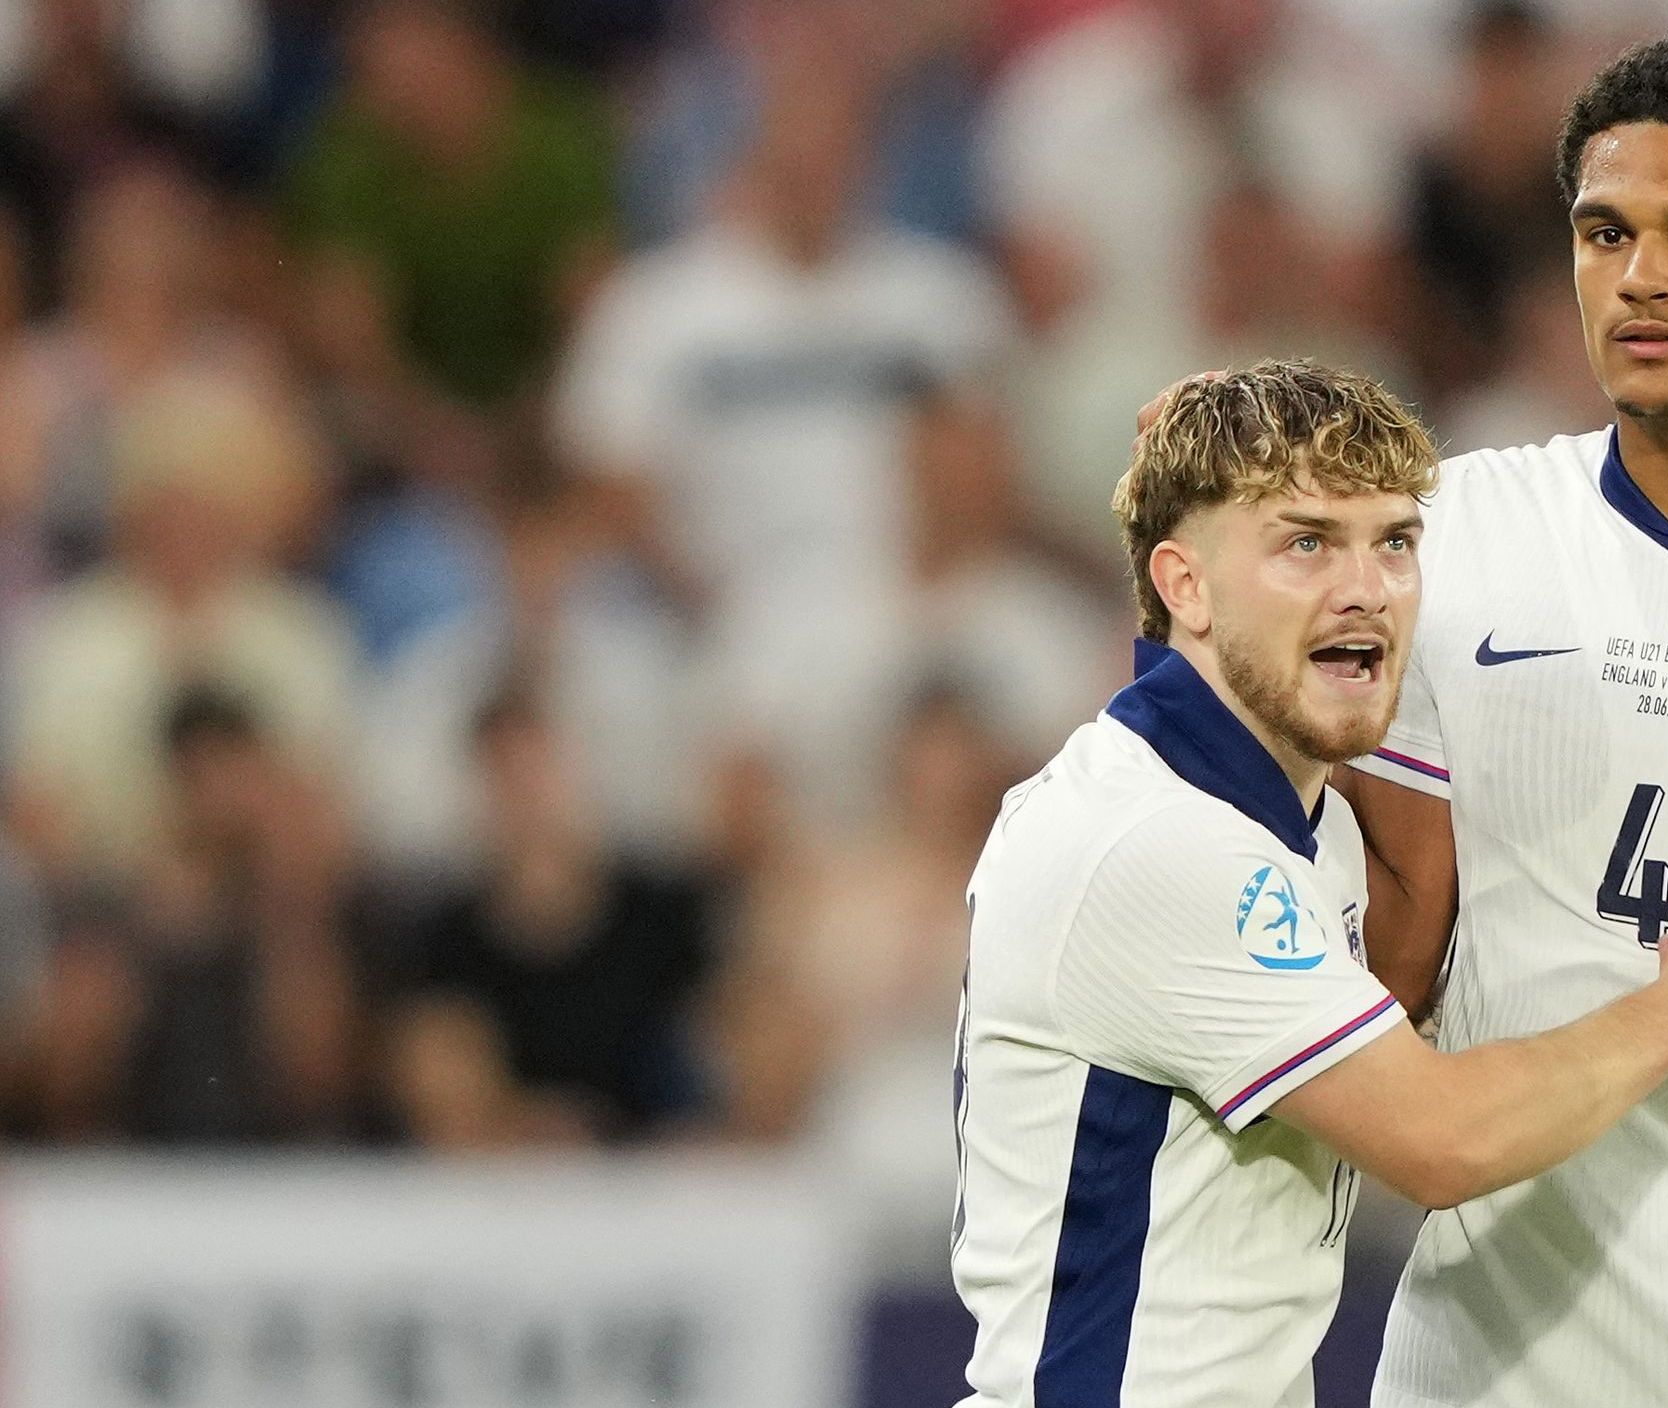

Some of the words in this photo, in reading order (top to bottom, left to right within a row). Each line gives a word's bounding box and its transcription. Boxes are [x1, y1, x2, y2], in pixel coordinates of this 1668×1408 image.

[1606, 637, 1635, 658] UEFA
[1640, 642, 1661, 661] U21
[1601, 663, 1657, 688] ENGLAND
[1661, 676, 1668, 689] v
